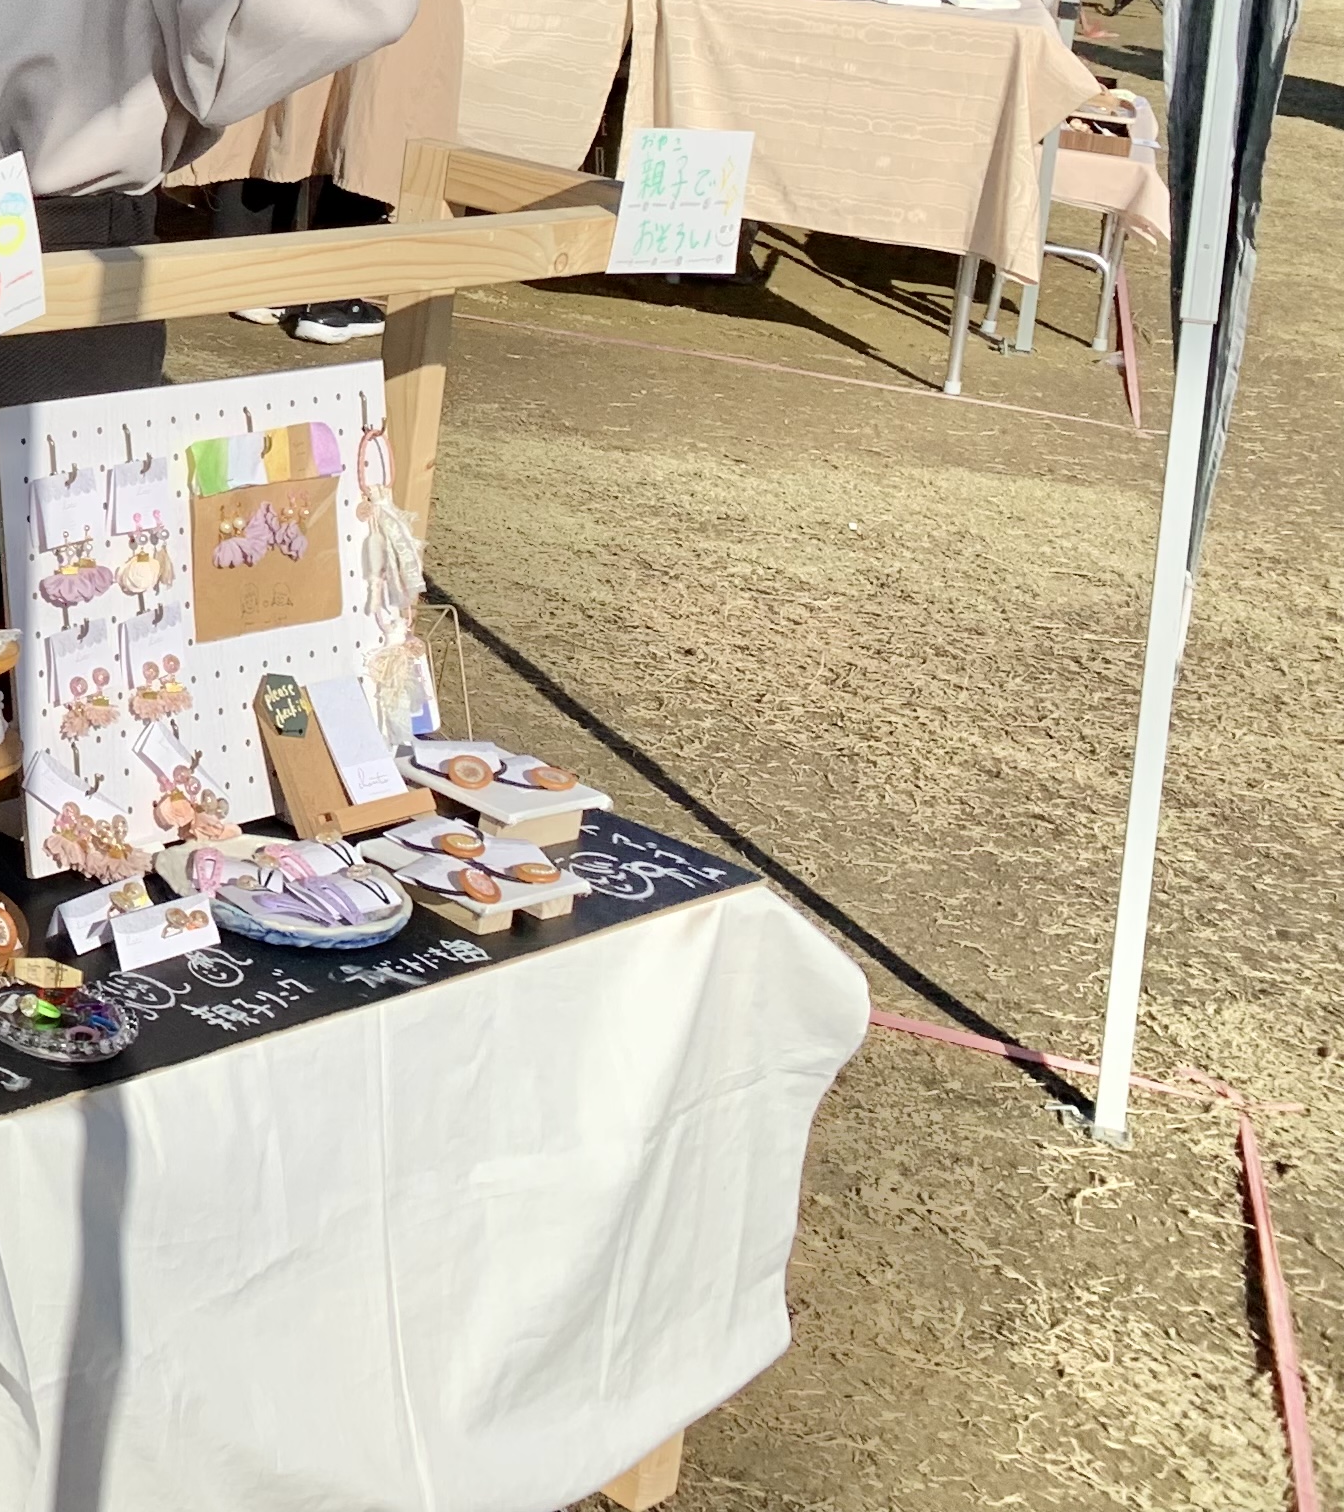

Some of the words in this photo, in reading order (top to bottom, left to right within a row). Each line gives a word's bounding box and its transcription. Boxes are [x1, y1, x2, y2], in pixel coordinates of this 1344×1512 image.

[640, 156, 716, 201] 親子で
[633, 220, 710, 256] おそろい
[264, 684, 296, 712] please
[181, 968, 315, 1032] 親子リング
